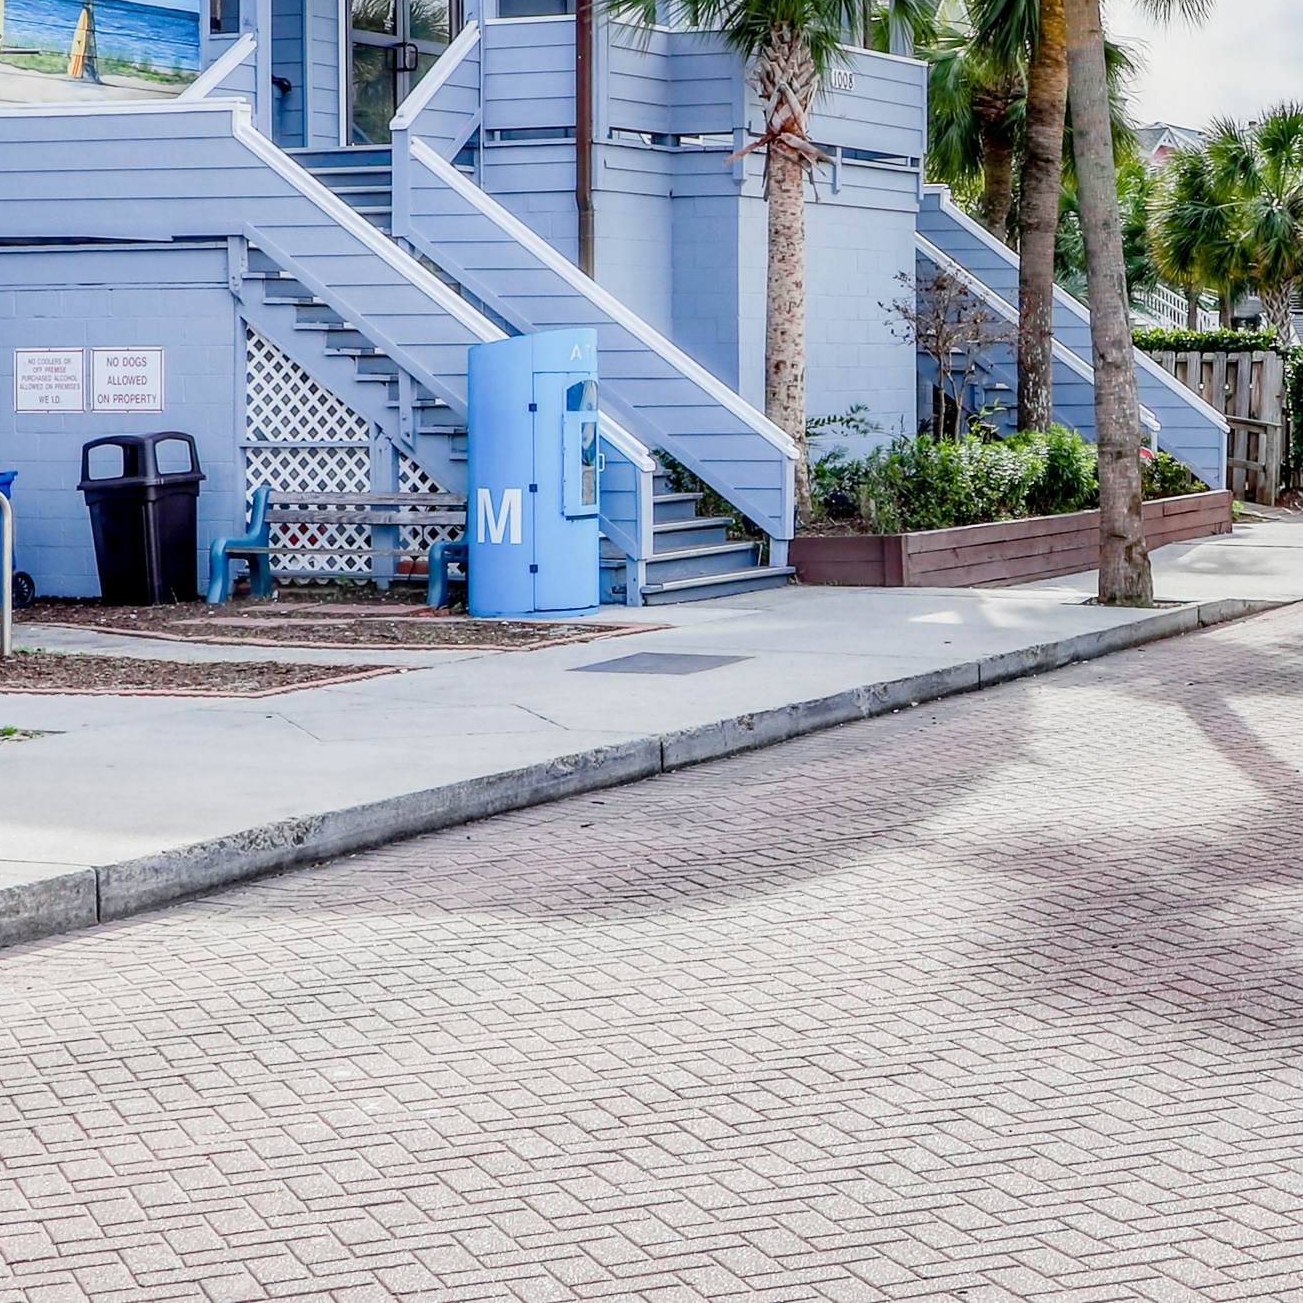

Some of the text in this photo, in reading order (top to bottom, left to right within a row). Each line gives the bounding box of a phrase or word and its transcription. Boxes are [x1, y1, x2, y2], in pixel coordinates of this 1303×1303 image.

[834, 71, 853, 89] 1008
[106, 356, 147, 367] NO DOGS
[54, 374, 77, 382] ALCOHOL
[106, 375, 148, 386] ALLOWED
[97, 393, 157, 404] ON PROPERTY
[477, 488, 522, 544] M
